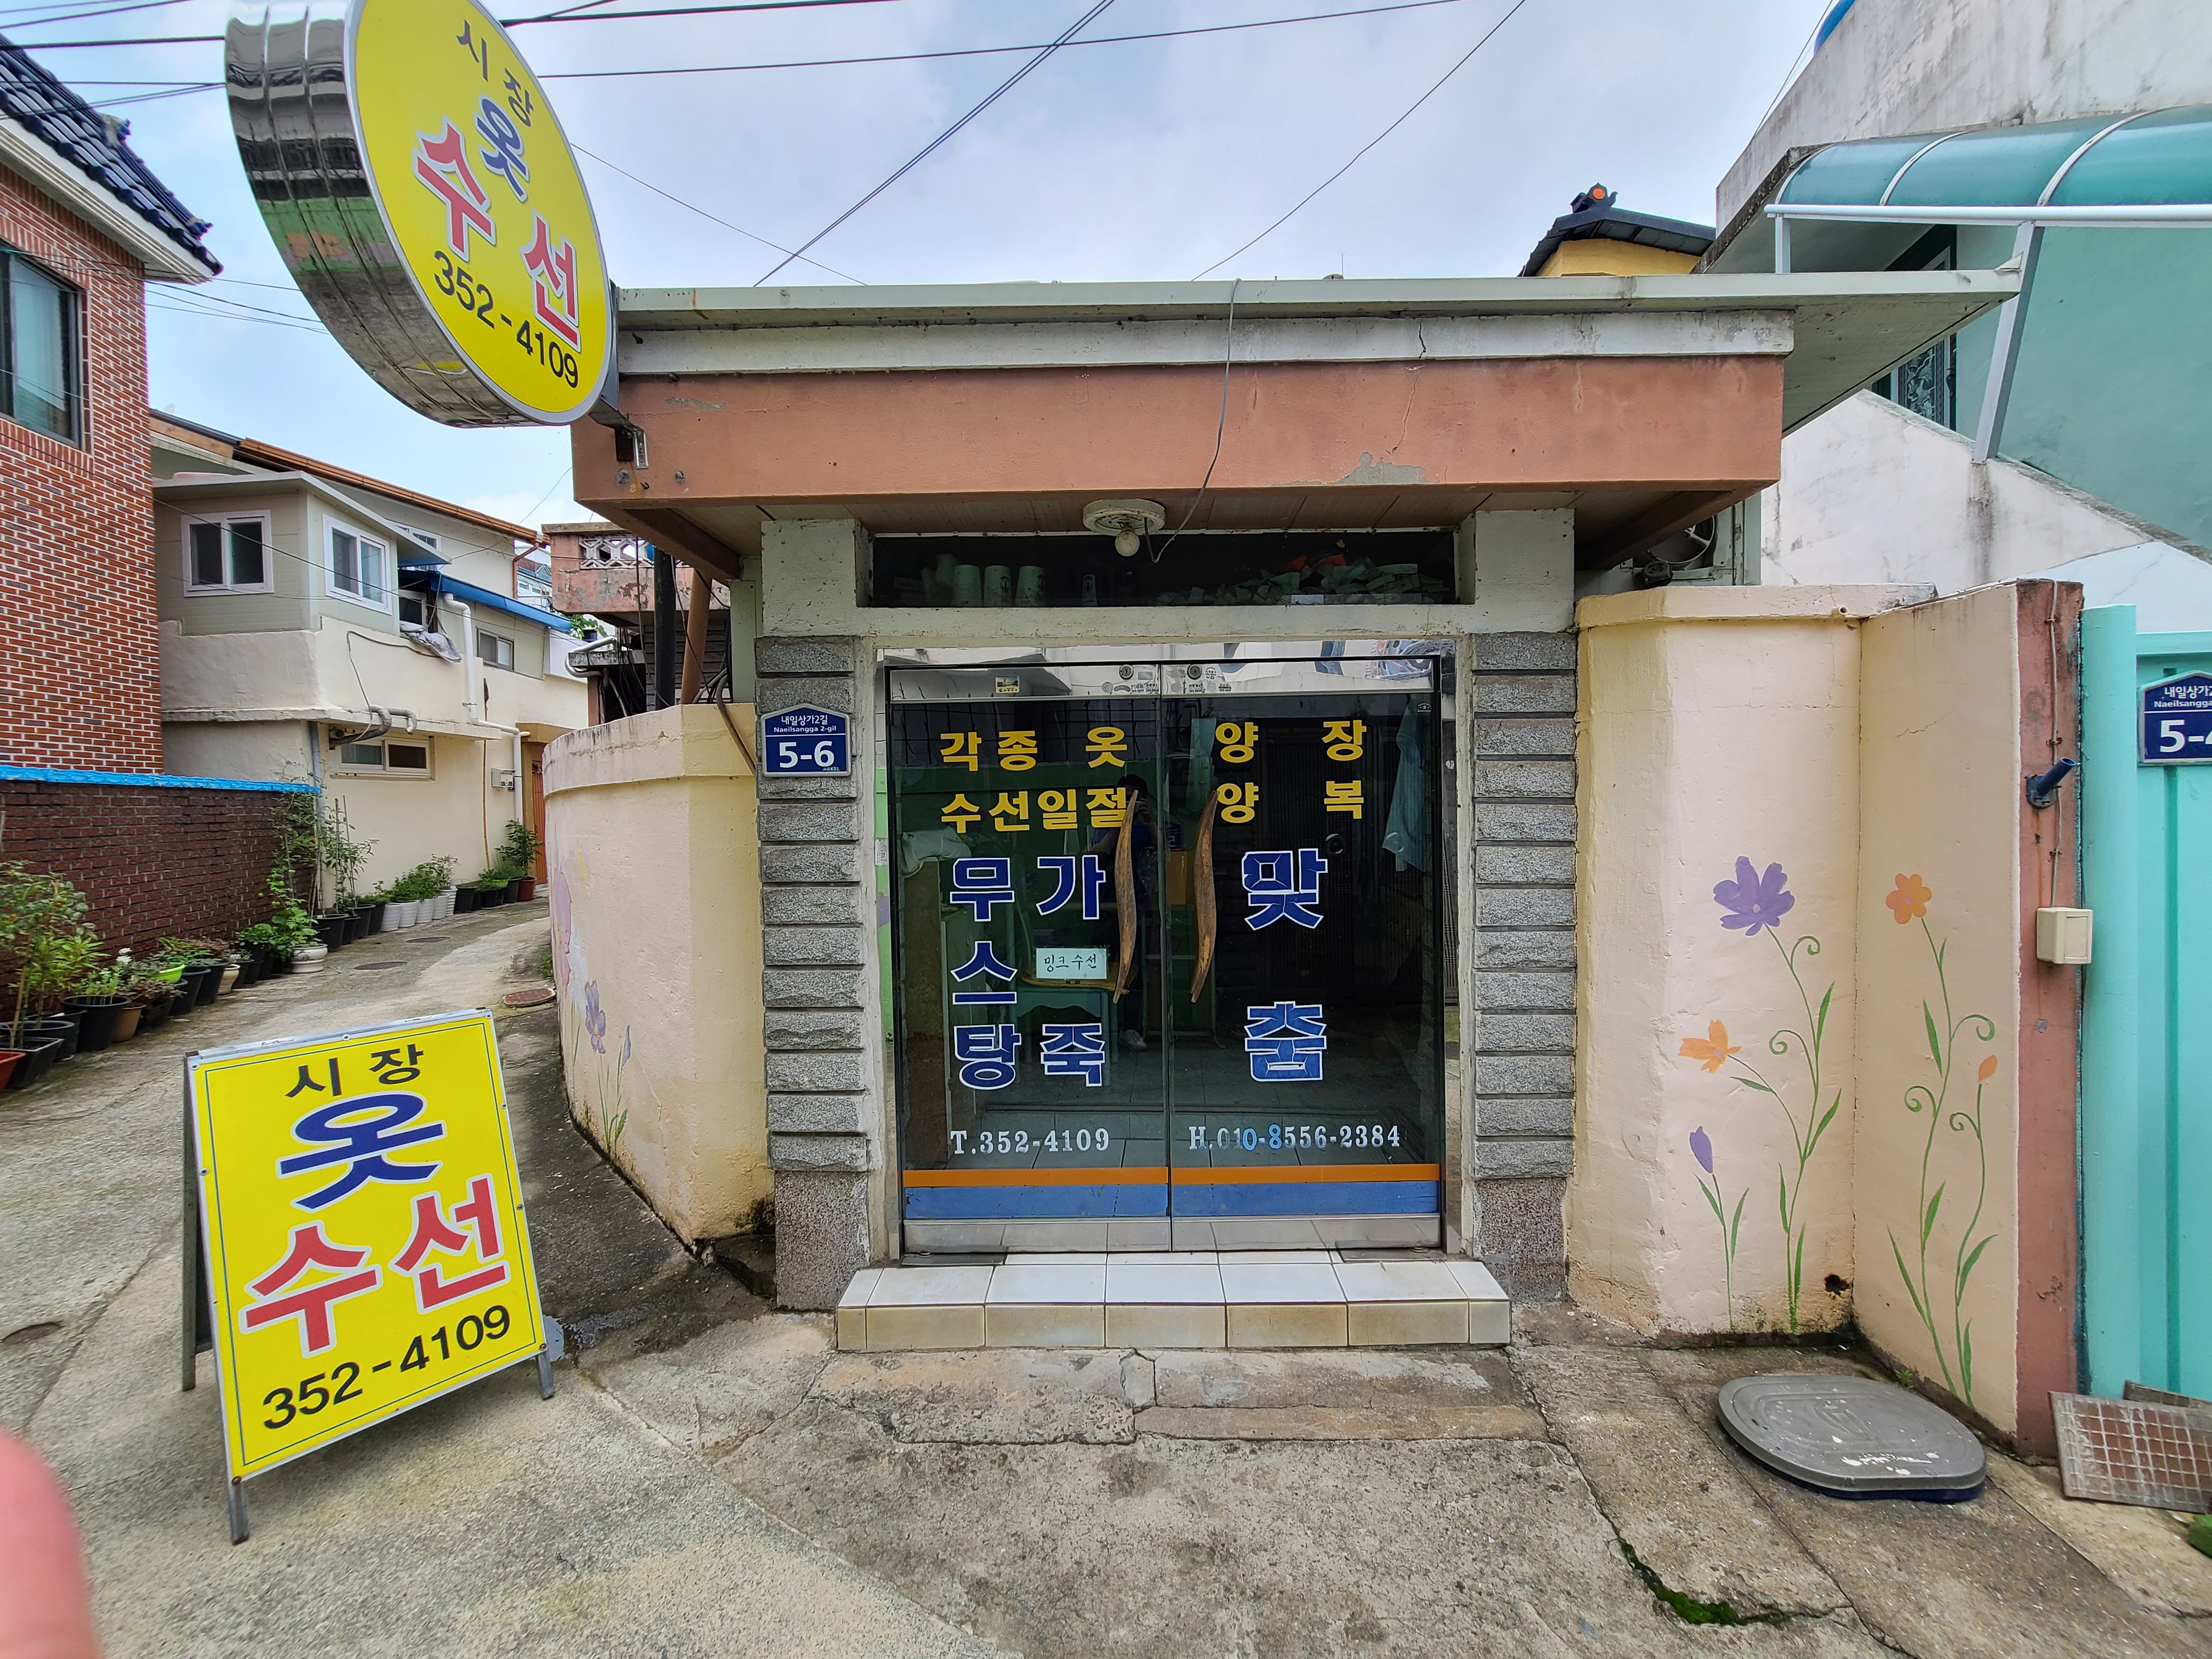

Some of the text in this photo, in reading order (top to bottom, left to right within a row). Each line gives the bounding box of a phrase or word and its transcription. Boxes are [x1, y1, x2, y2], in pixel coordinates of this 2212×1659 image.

[456, 20, 534, 127] 시장
[476, 95, 529, 202] 옷
[412, 115, 582, 352] 수선
[433, 250, 579, 388] 352-4109
[781, 715, 828, 726] 내일상가2길
[1215, 720, 1367, 763] 양장
[2159, 719, 2212, 753] 5-
[779, 741, 834, 768] 5-6
[940, 726, 1127, 771] 각종 옷
[941, 787, 1127, 833] 수선일절
[1217, 780, 1364, 823] 양복
[1044, 953, 1097, 972] 밍크 수선
[286, 1043, 424, 1098] 시장
[276, 1091, 445, 1211] 옷
[239, 1172, 511, 1358] 수선
[262, 1304, 511, 1430] 352-4109
